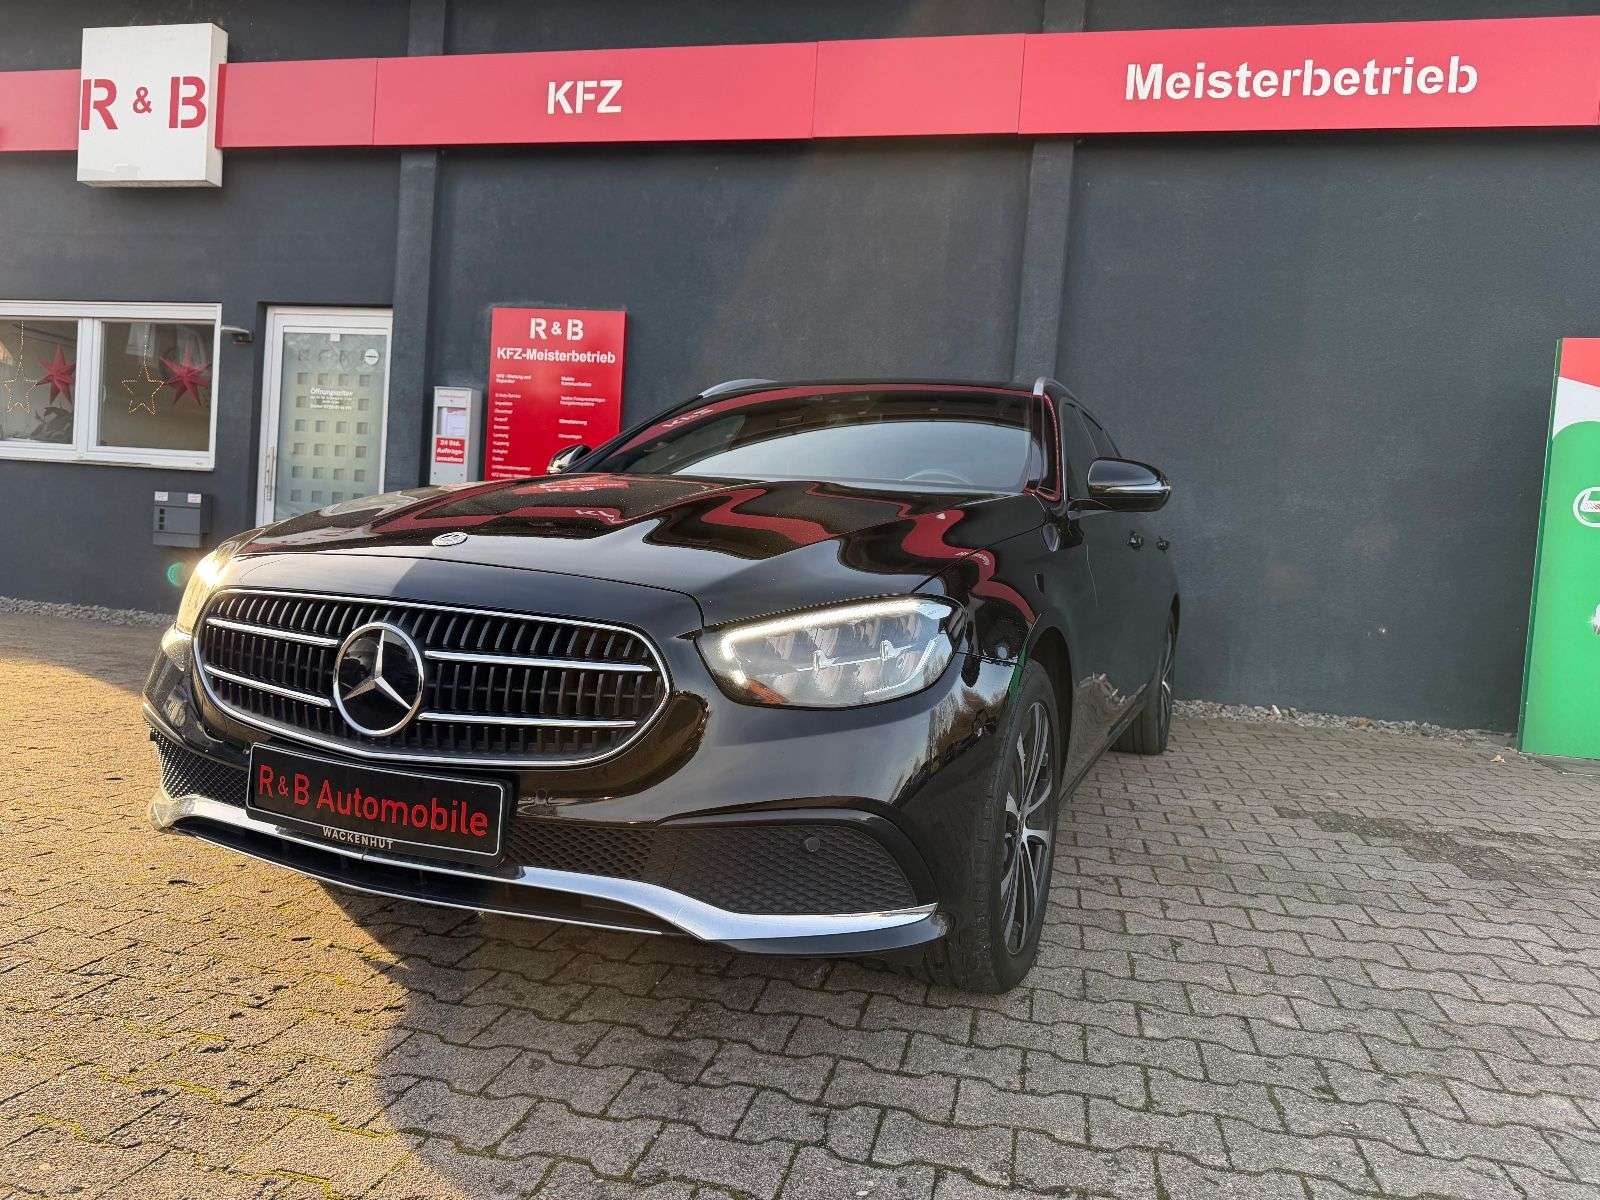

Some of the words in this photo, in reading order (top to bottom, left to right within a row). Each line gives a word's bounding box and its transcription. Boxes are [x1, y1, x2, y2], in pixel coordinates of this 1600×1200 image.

[1124, 55, 1479, 101] Meisterbetrieb
[80, 78, 118, 130] R
[132, 86, 152, 114] &
[168, 76, 207, 128] B
[546, 79, 623, 114] KFZ
[529, 317, 547, 340] R
[550, 321, 563, 336] &
[566, 318, 584, 341] B
[496, 347, 616, 364] KFZ-Meisterbetrieb
[257, 764, 275, 798] R
[277, 775, 289, 798] &
[293, 773, 311, 806] B
[316, 779, 489, 837] Automobile
[321, 826, 394, 850] WACKENHUT
